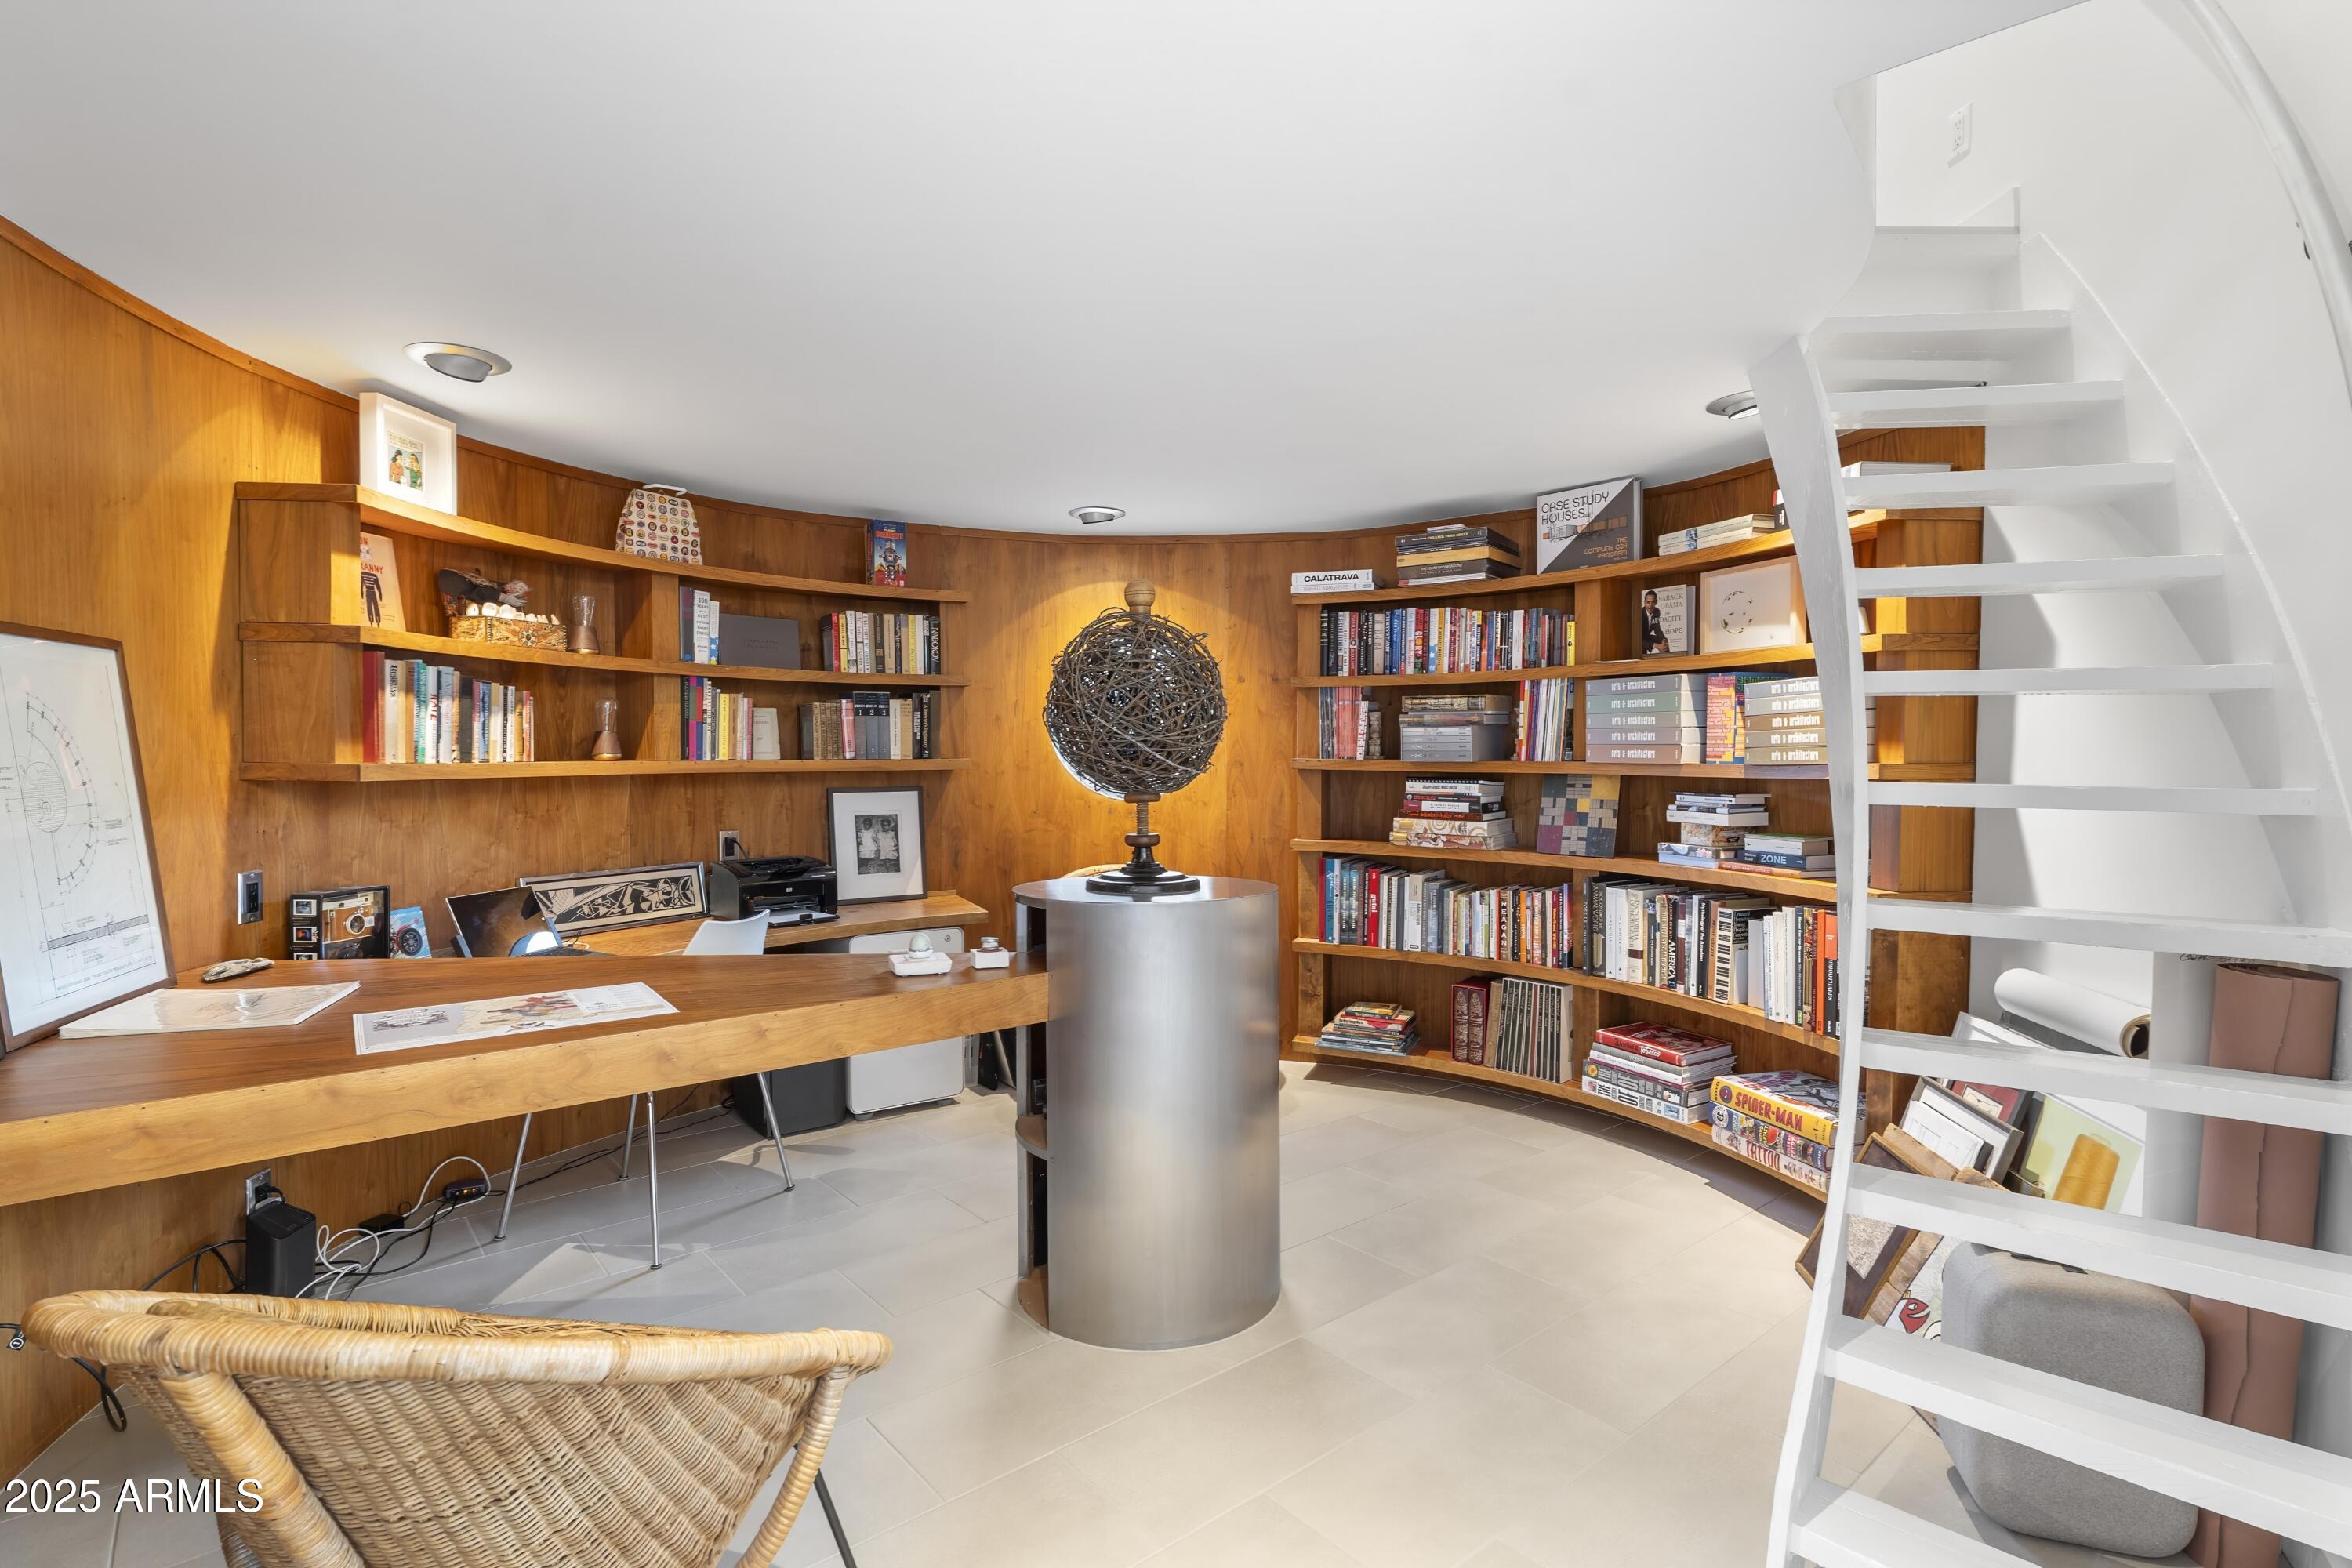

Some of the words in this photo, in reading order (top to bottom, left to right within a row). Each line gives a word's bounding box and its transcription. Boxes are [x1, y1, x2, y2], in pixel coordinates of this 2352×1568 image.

[1541, 499, 1570, 514] CASE
[1573, 492, 1610, 507] STUDY
[1541, 508, 1585, 525] HOUSES
[1584, 545, 1614, 554] COMPLETE
[1304, 574, 1359, 583] CALATRAVA
[1658, 593, 1683, 602] BARACK
[1651, 615, 1682, 624] AUDACITY
[1611, 682, 1621, 691] arts
[1627, 679, 1656, 690] architecture
[1771, 684, 1781, 694] arts
[1788, 679, 1819, 692] architecture
[1611, 699, 1621, 709] arts
[1627, 698, 1656, 708] architecture
[1771, 699, 1782, 710] arts
[1788, 697, 1820, 710] architecture
[1612, 716, 1621, 725] arts
[1628, 715, 1656, 724] architecture
[1772, 717, 1782, 728] arts
[1789, 713, 1820, 726] architecture
[1611, 732, 1621, 741] arts
[1627, 731, 1656, 741] architecture
[1771, 733, 1781, 744] arts
[1788, 731, 1819, 743] architecture
[1611, 750, 1621, 758] arts
[1627, 748, 1656, 759] architecture
[1771, 750, 1781, 760] arts
[1788, 749, 1819, 761] architecture
[1760, 854, 1788, 864] ZONE
[1618, 1073, 1639, 1091] OF
[1598, 1083, 1610, 1097] THE
[1618, 1089, 1638, 1106] OF
[1734, 1091, 1803, 1131] SPIDER-MAN
[1745, 1139, 1780, 1171] TATTOO
